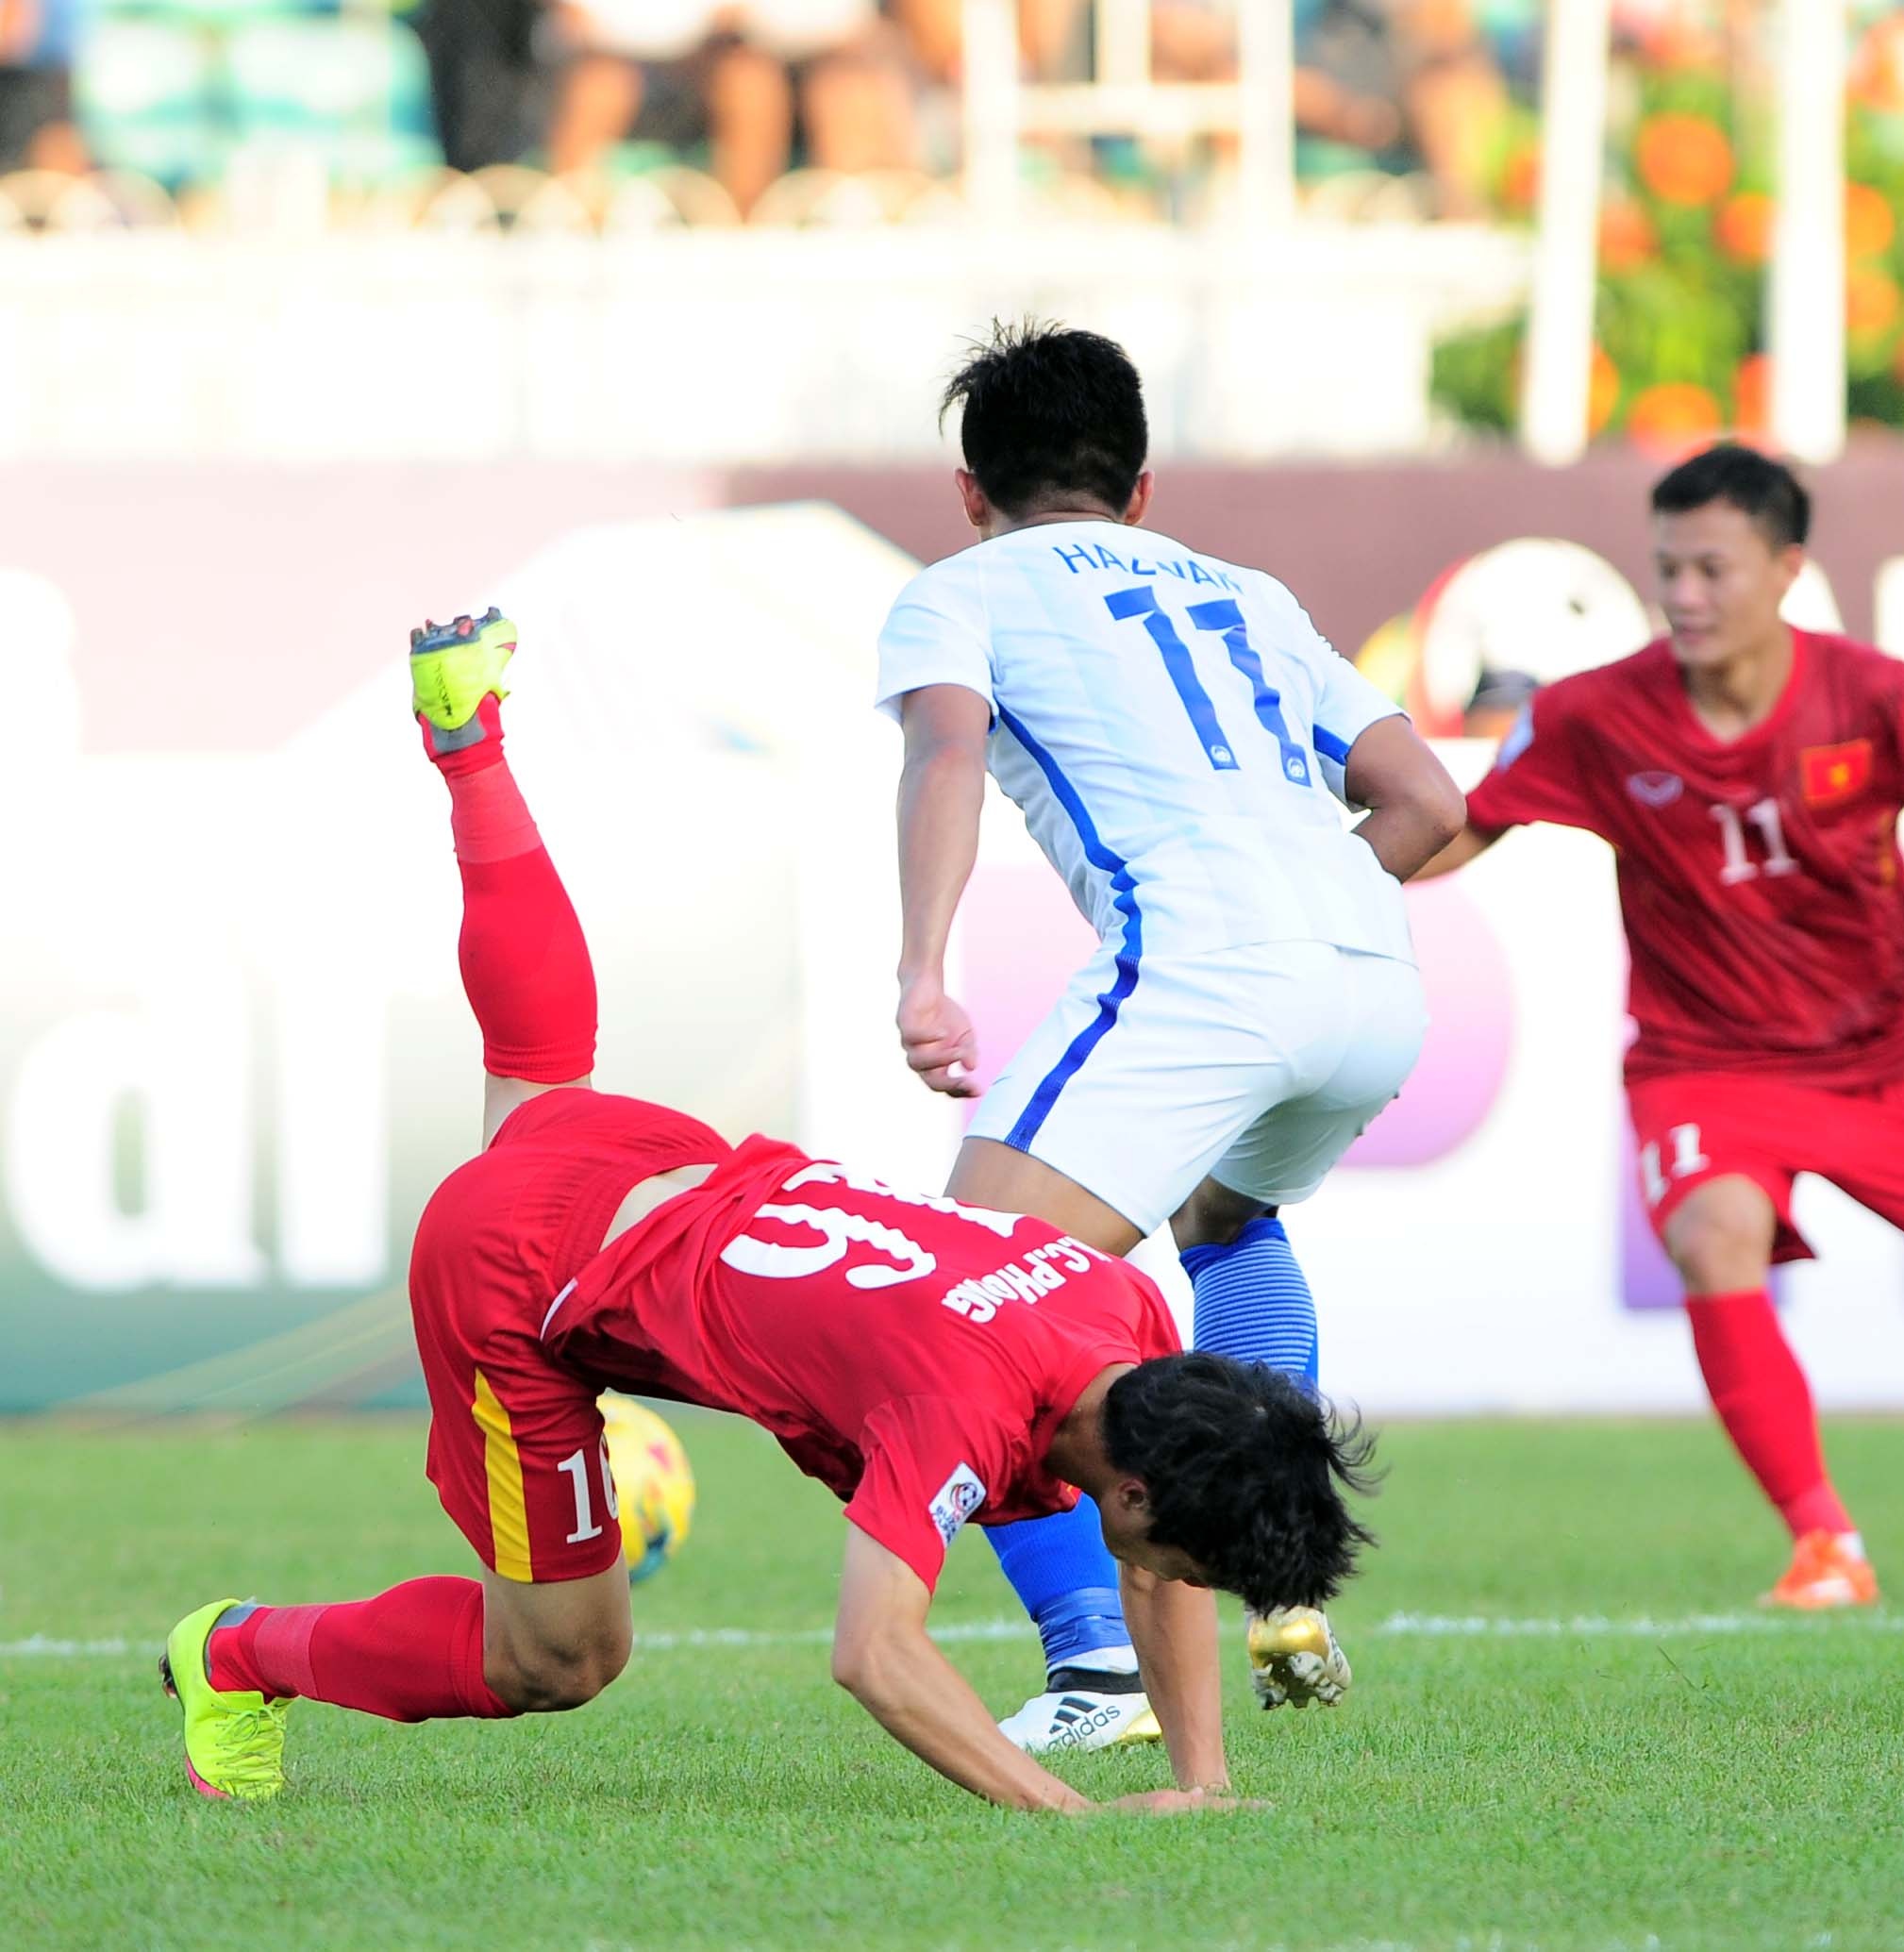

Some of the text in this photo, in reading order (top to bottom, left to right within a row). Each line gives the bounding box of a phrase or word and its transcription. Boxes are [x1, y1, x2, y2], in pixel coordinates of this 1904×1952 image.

[1103, 585, 1312, 788] 11
[1709, 798, 1799, 886] 11
[1641, 1122, 1712, 1209] 11
